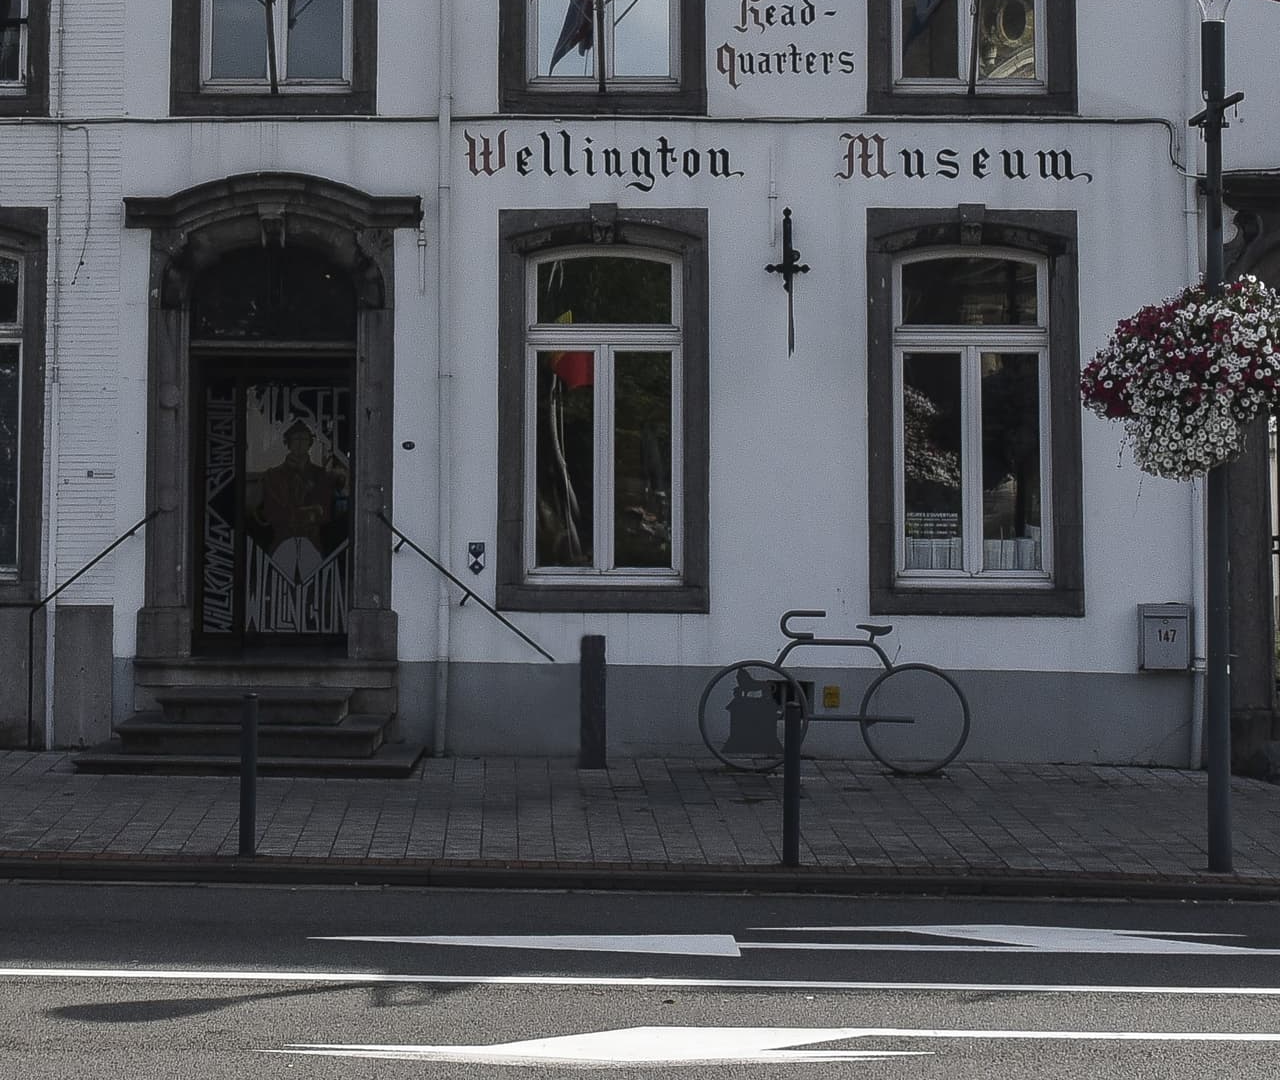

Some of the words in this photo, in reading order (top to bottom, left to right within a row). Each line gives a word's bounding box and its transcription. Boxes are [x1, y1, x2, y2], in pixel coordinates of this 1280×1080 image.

[716, 41, 856, 90] Quarters
[463, 128, 745, 193] Wellington
[834, 132, 1093, 184] Museum
[1158, 628, 1177, 642] 147
